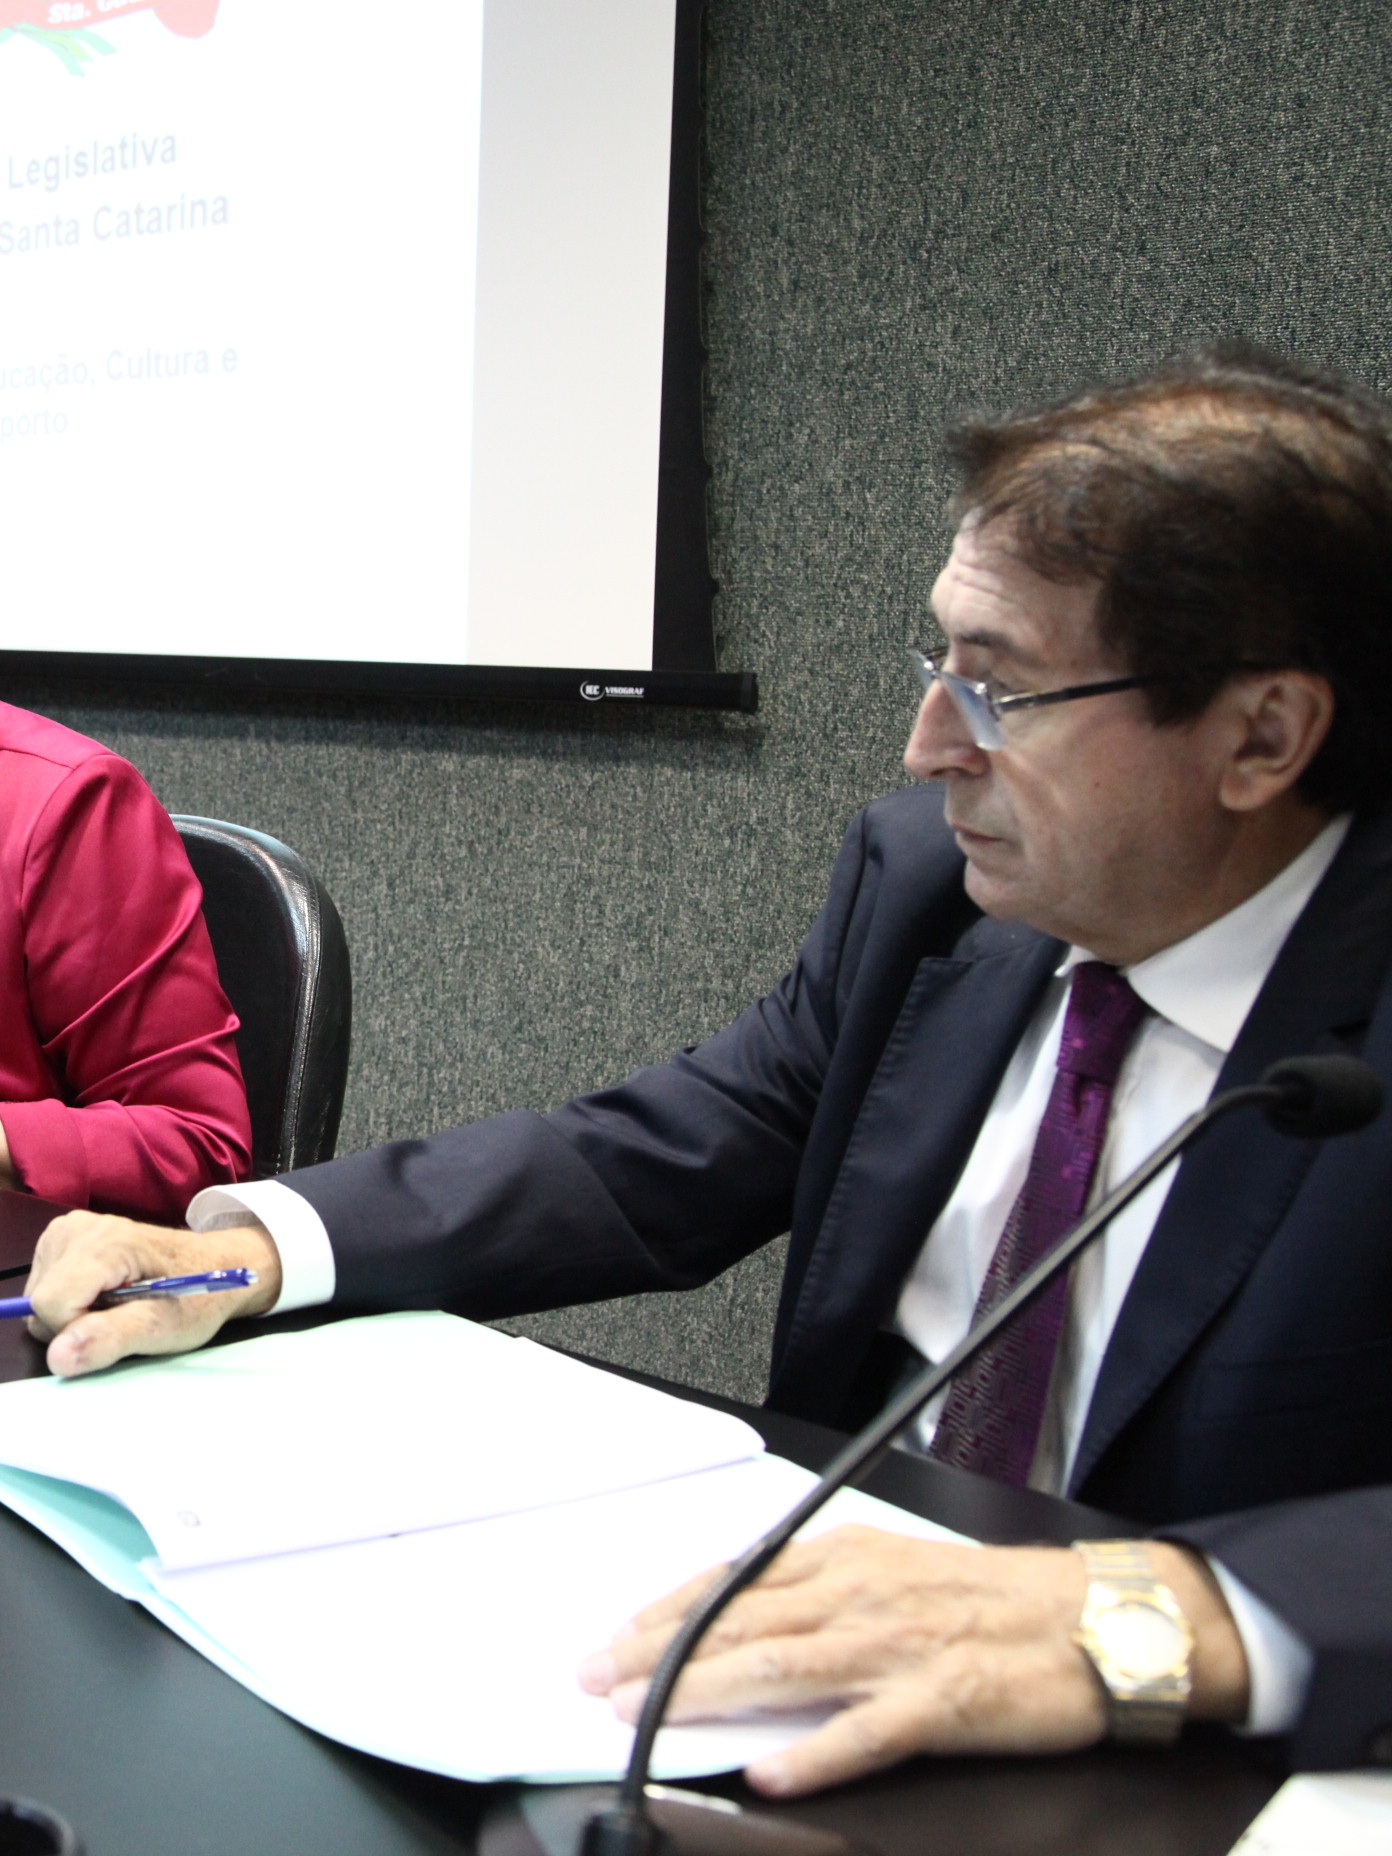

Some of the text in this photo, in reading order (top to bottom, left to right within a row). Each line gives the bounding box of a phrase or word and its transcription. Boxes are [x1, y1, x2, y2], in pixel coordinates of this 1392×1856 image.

[8, 132, 177, 192] Legislativa
[93, 192, 230, 241] Catarina
[106, 347, 210, 381] Cultura
[222, 349, 239, 372] e
